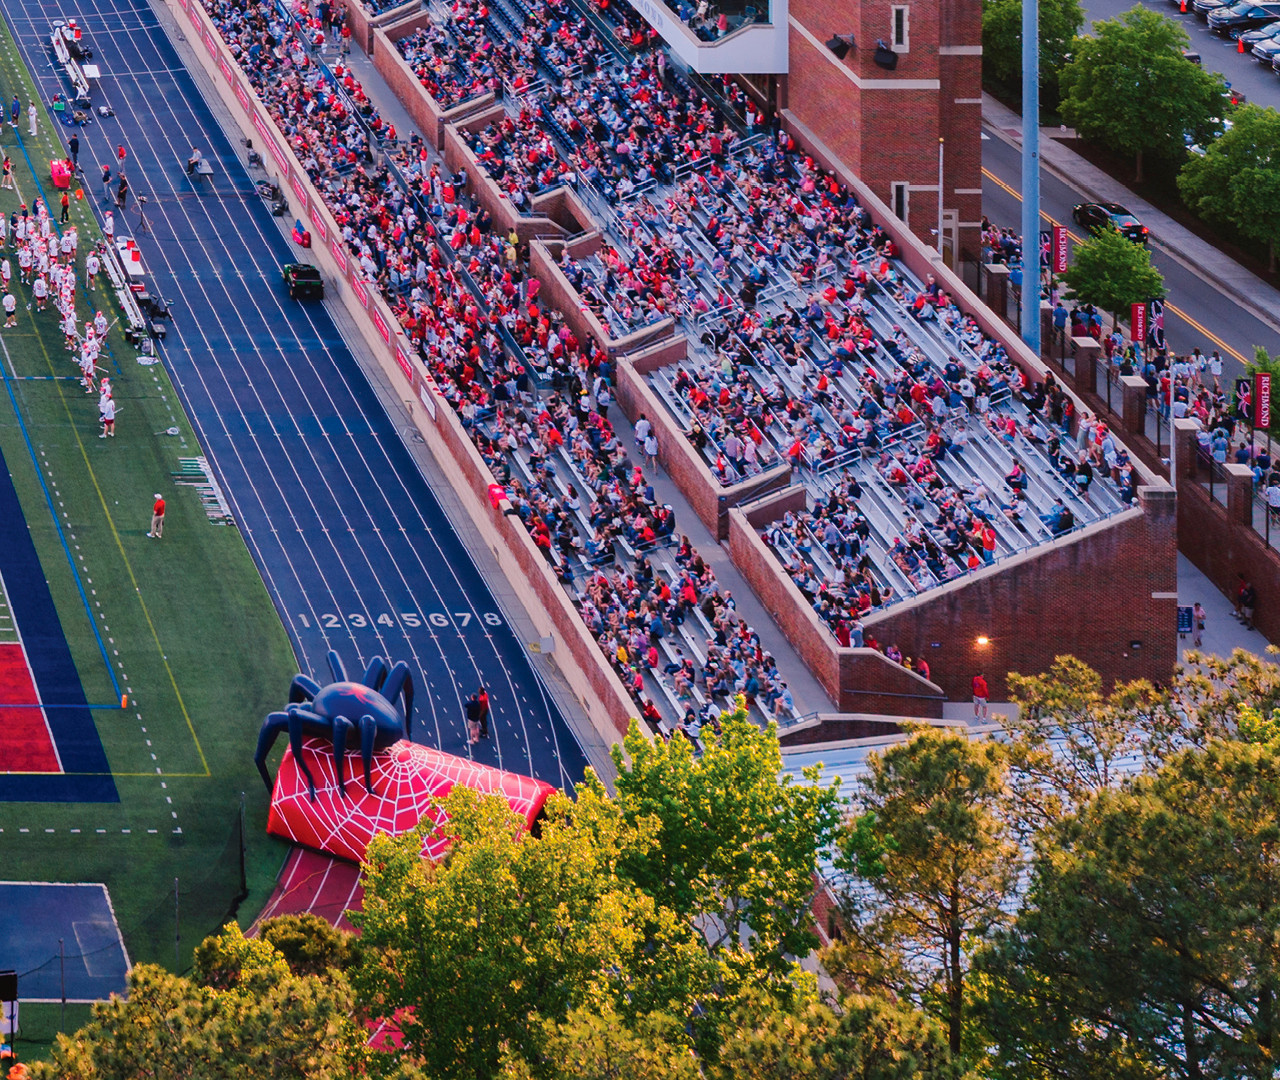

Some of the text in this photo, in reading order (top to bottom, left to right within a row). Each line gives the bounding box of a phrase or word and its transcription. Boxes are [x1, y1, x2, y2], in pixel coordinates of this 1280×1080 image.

[1058, 227, 1067, 271] RICHMOND
[1137, 305, 1145, 340] RICHMOND
[1261, 376, 1270, 427] RICHMOND
[298, 612, 503, 628] 1 2 3 4 5 6 7 8
